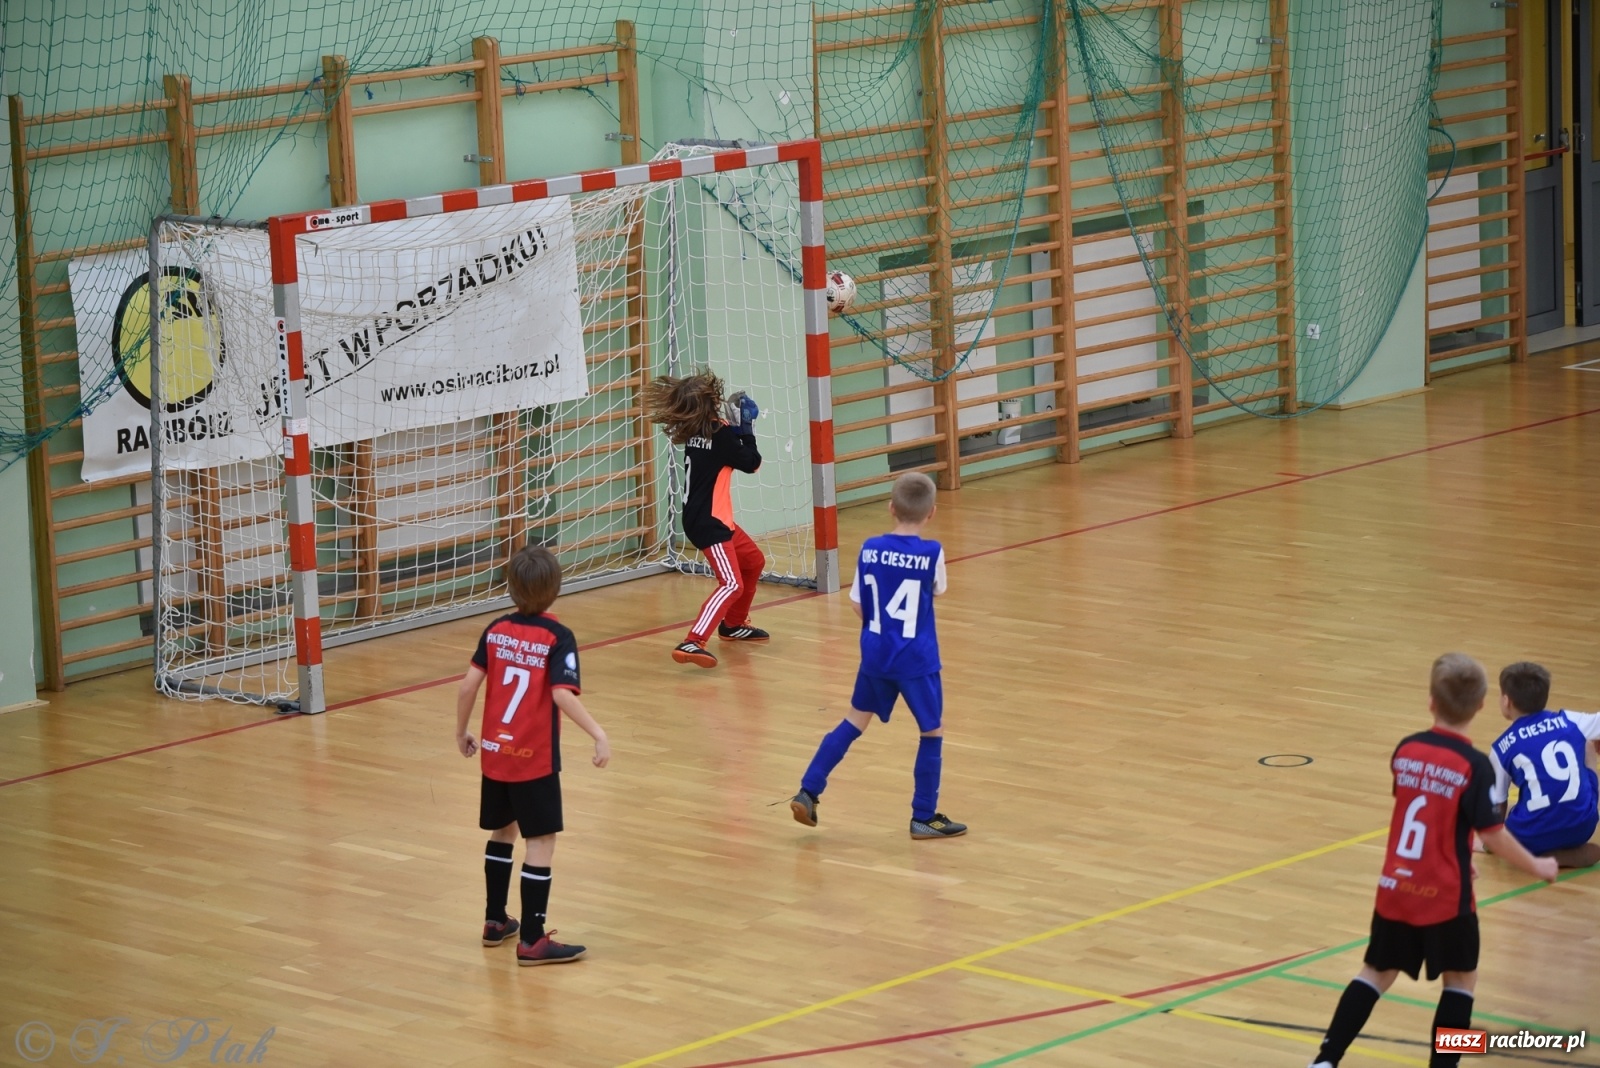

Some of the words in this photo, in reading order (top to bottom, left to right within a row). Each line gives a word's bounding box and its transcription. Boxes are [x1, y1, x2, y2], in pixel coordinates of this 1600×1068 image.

[336, 211, 359, 225] sport
[338, 328, 371, 367] W
[281, 368, 289, 415] sport
[117, 409, 234, 454] RAIBÓZ
[862, 549, 878, 564] UKS
[881, 551, 930, 570] CIESZYN
[863, 574, 921, 638] 14
[502, 666, 530, 724] 7
[1498, 732, 1516, 754] UKS
[1518, 716, 1568, 740] CIESZYN
[1512, 740, 1580, 812] 19
[1395, 795, 1427, 860] 6
